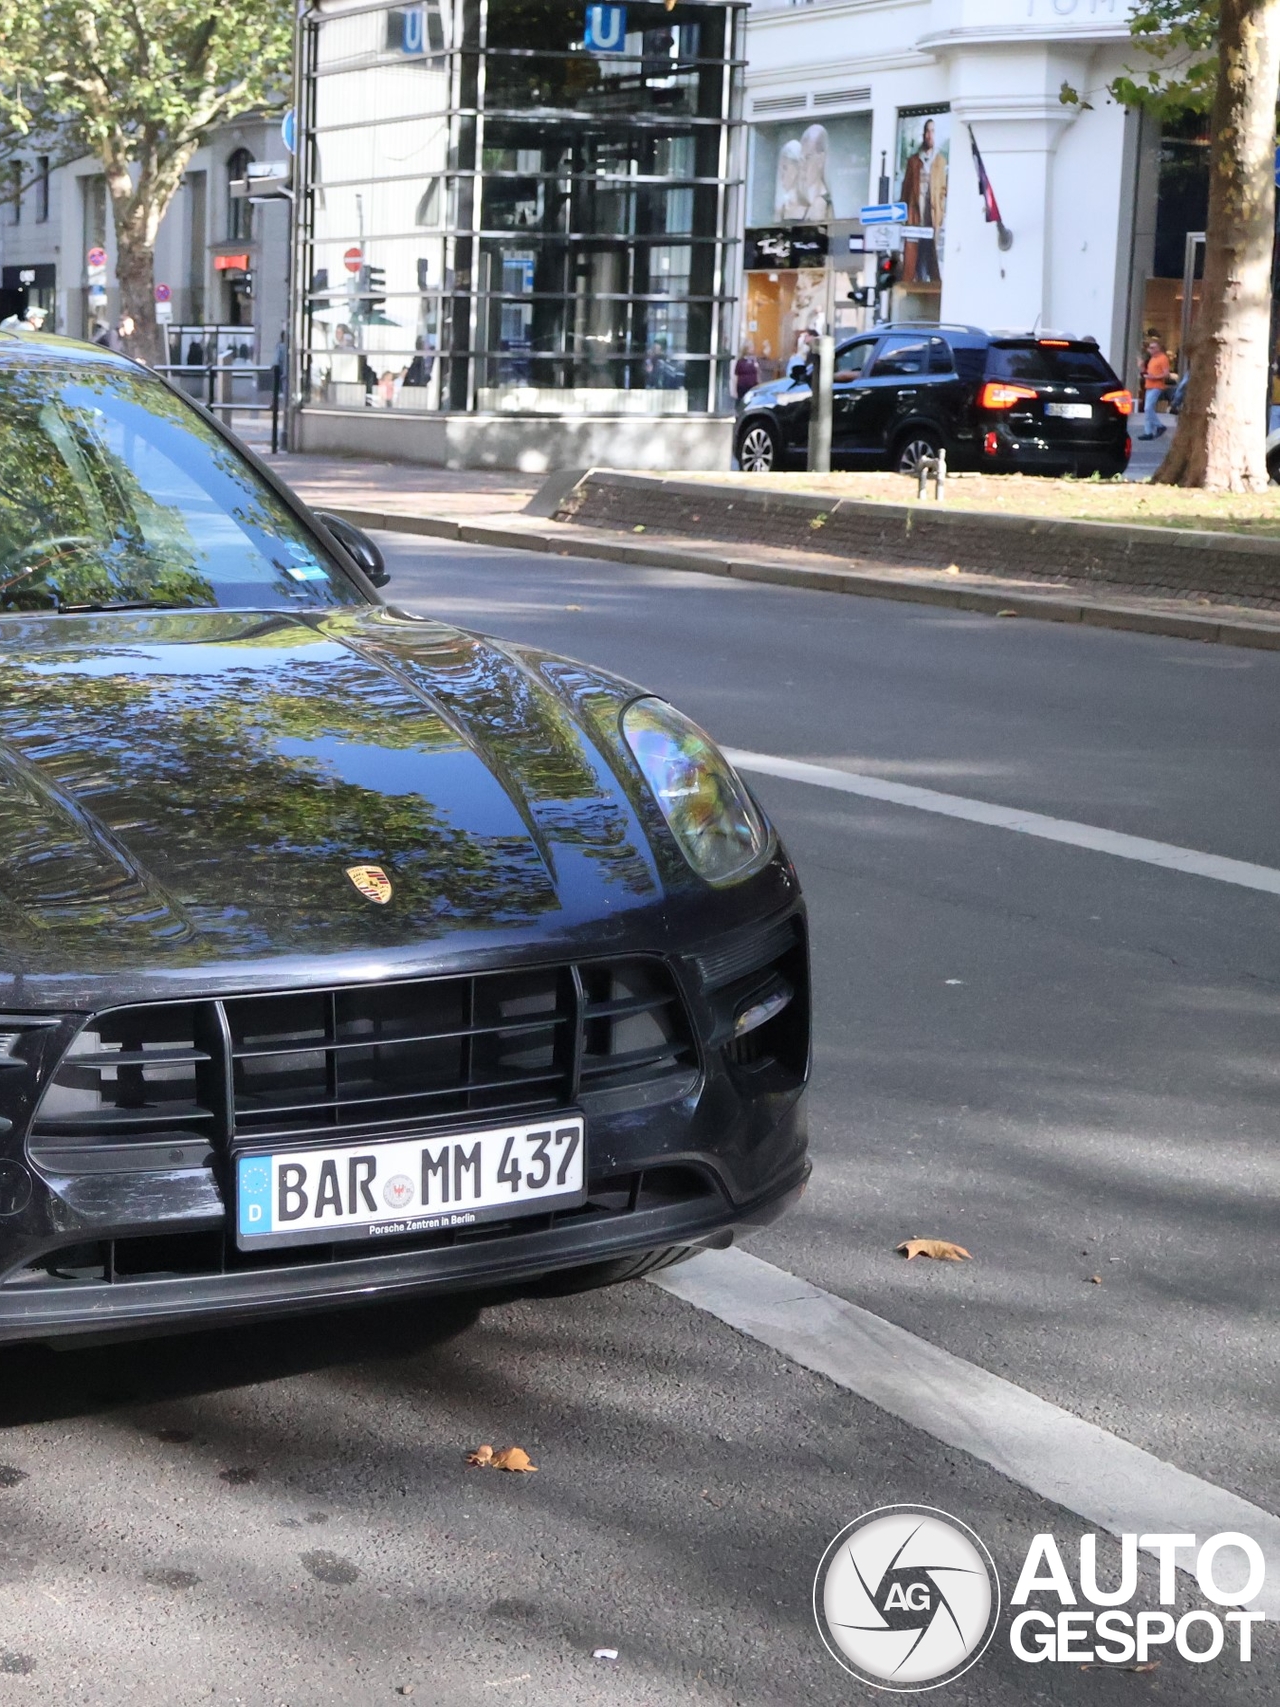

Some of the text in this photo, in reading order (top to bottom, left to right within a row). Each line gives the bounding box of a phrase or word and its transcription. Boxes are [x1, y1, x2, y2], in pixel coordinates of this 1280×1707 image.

[591, 6, 620, 48] U
[277, 1154, 378, 1222] BAR
[421, 1140, 482, 1206] MM
[496, 1126, 580, 1193] 437
[248, 1204, 262, 1222] D
[369, 1213, 476, 1235] Porsche Zentren in Berlin
